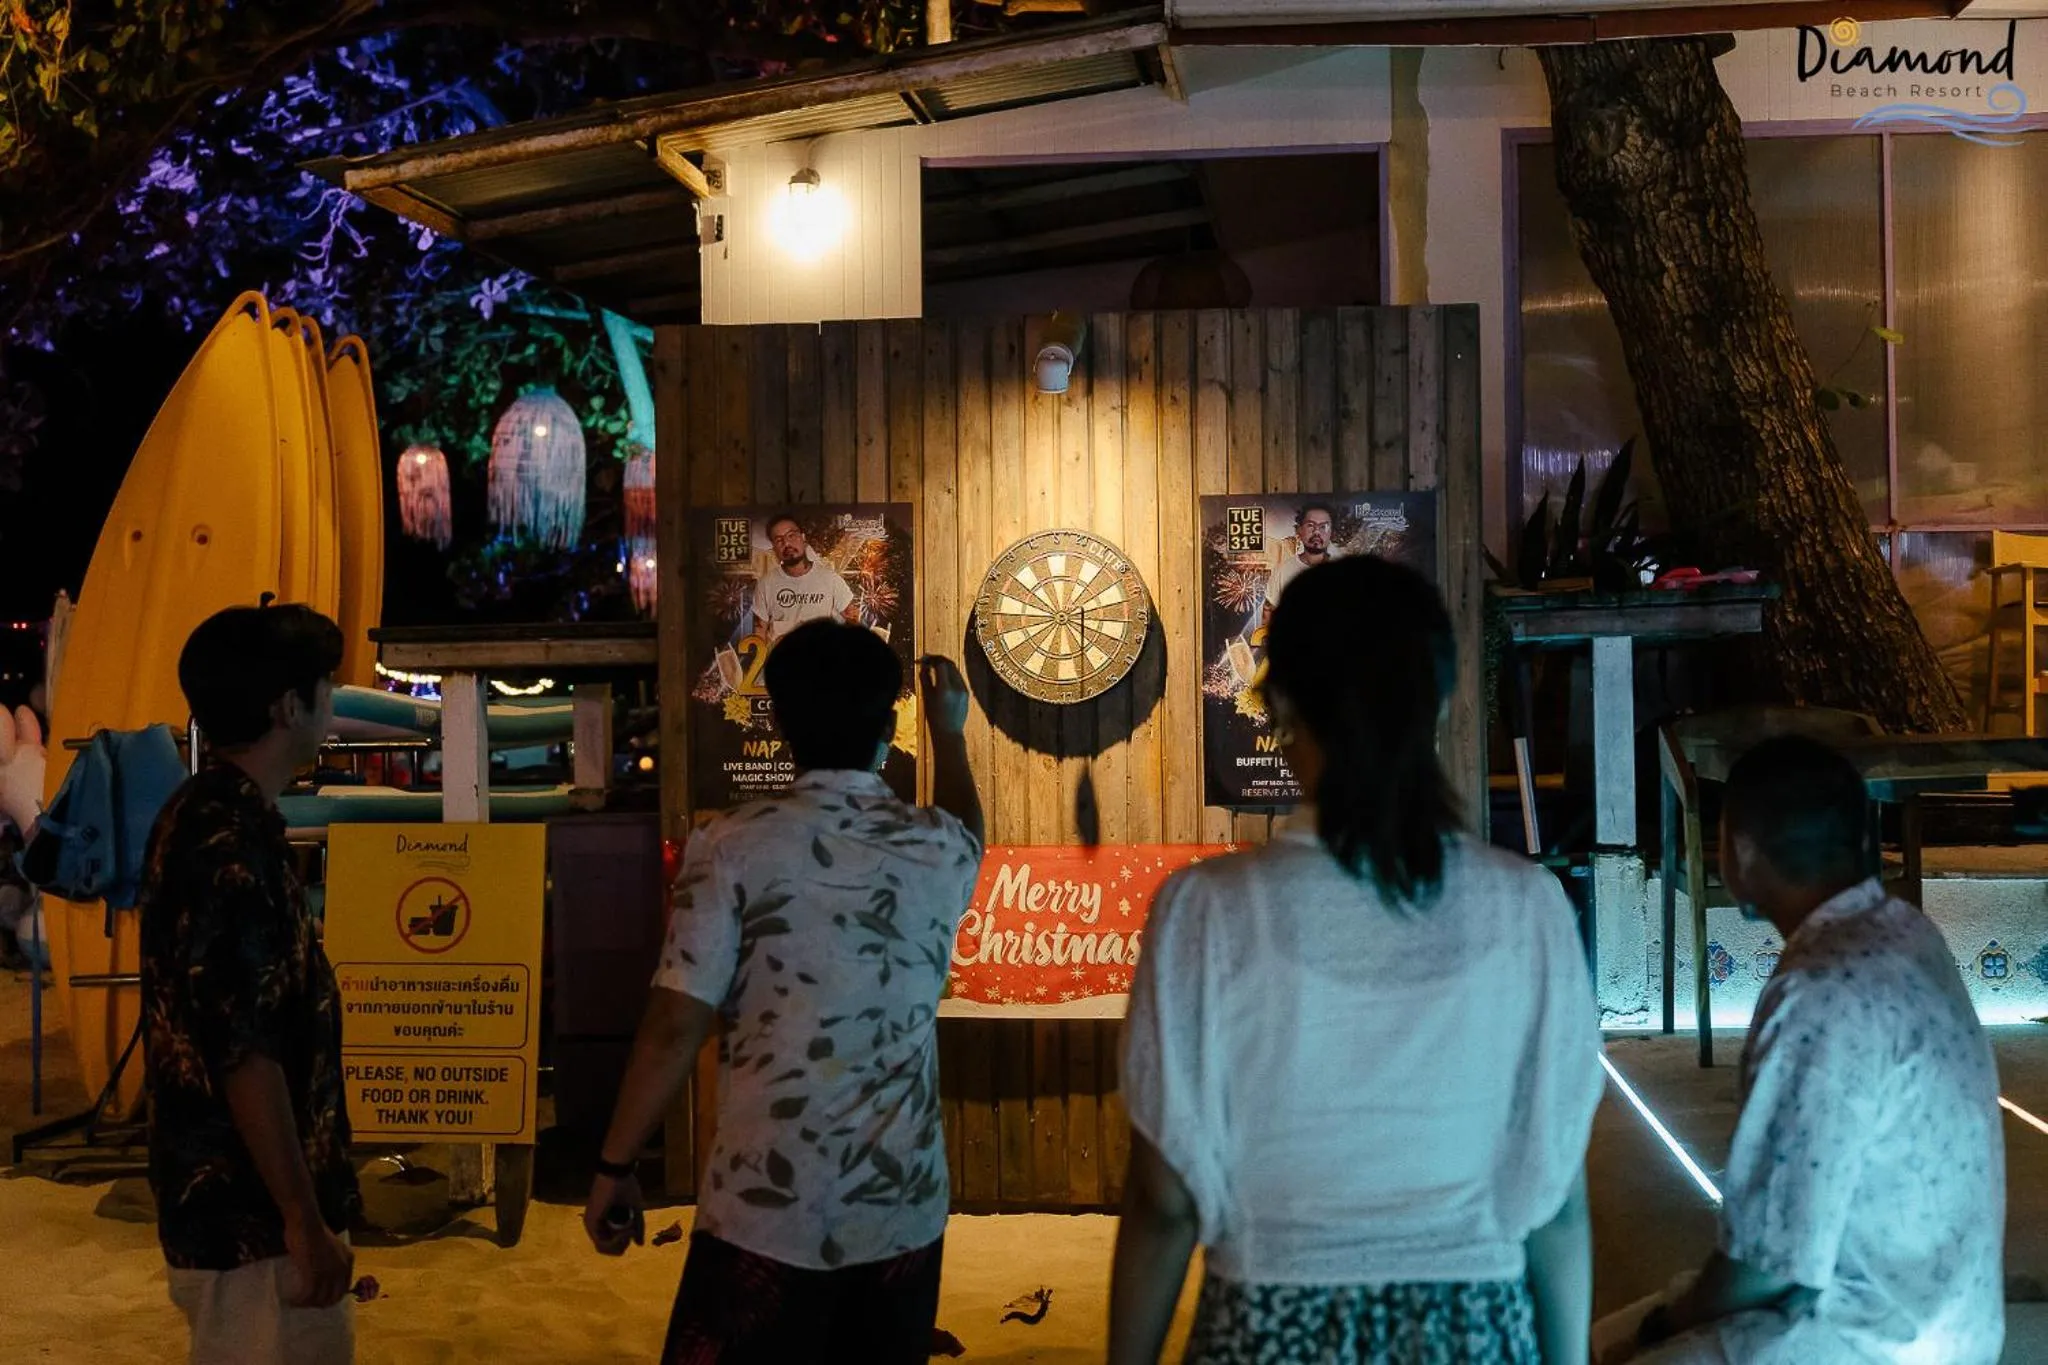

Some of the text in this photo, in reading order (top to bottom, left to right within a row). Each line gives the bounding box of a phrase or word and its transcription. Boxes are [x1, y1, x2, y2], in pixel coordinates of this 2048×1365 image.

[1231, 509, 1260, 522] TUE
[720, 521, 748, 533] TUE
[1230, 523, 1262, 535] DEC
[719, 534, 749, 546] DEC
[1230, 535, 1261, 550] 31ST
[719, 546, 748, 560] 31ST
[743, 740, 783, 759] NAP
[723, 762, 743, 771] LIVE
[745, 762, 772, 771] BAND
[1236, 757, 1273, 767] BUFFET
[732, 773, 795, 783] MAGIC SHOW
[1241, 788, 1280, 798] RESERVE
[1281, 789, 1289, 798] A
[396, 832, 469, 854] Diamond
[985, 863, 1102, 924] Merry
[952, 908, 1142, 967] Christmas
[345, 1066, 509, 1084] PLEASE, NO OUTSIDE
[361, 1088, 489, 1105] FOOD OR DRINK.
[376, 1108, 473, 1125] THANK YOU!
